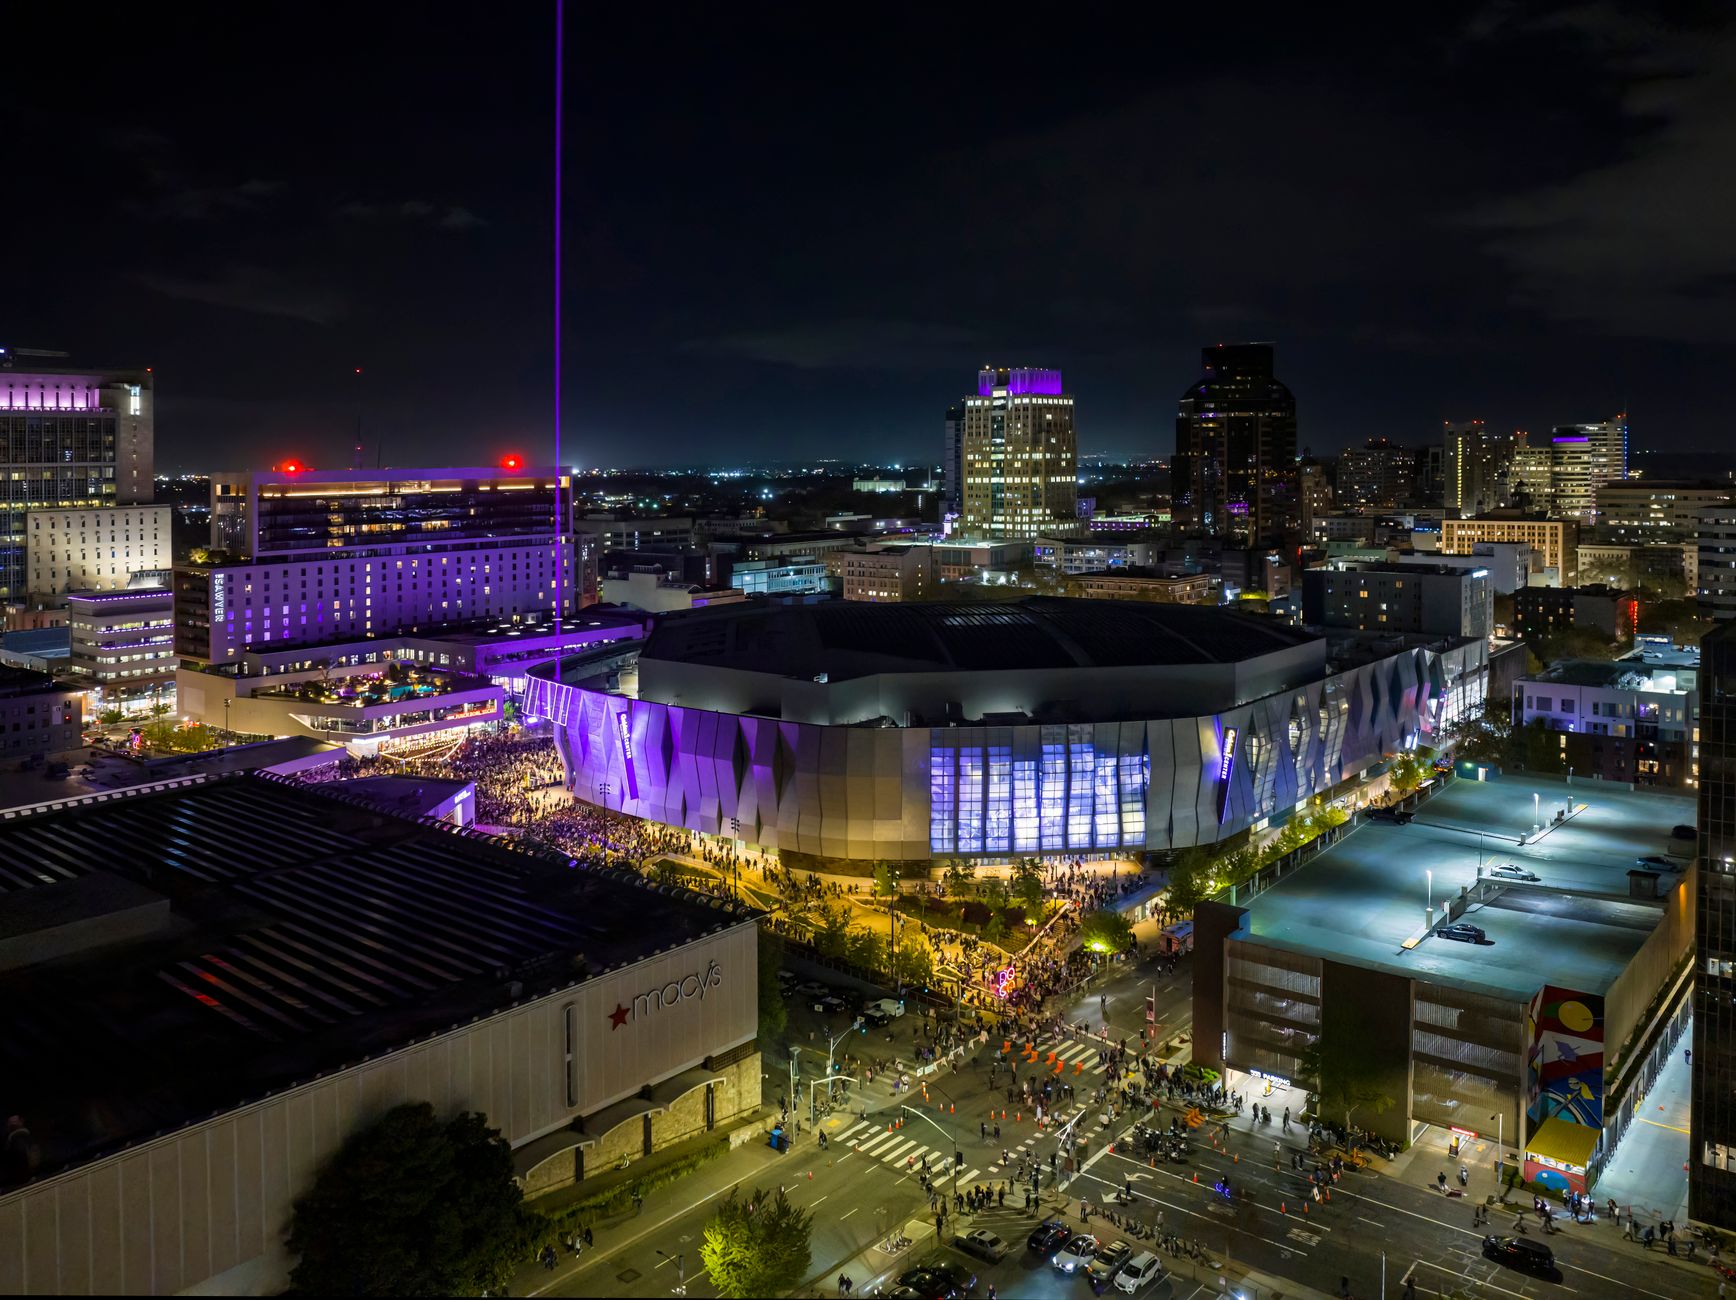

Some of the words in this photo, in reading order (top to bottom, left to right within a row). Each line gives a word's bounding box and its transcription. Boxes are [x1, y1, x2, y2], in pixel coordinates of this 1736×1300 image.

[214, 579, 225, 622] SAWYER
[624, 738, 632, 759] CENTER
[1226, 729, 1236, 752] Golden
[1221, 756, 1230, 779] CENTER
[1262, 1073, 1291, 1087] PARKING
